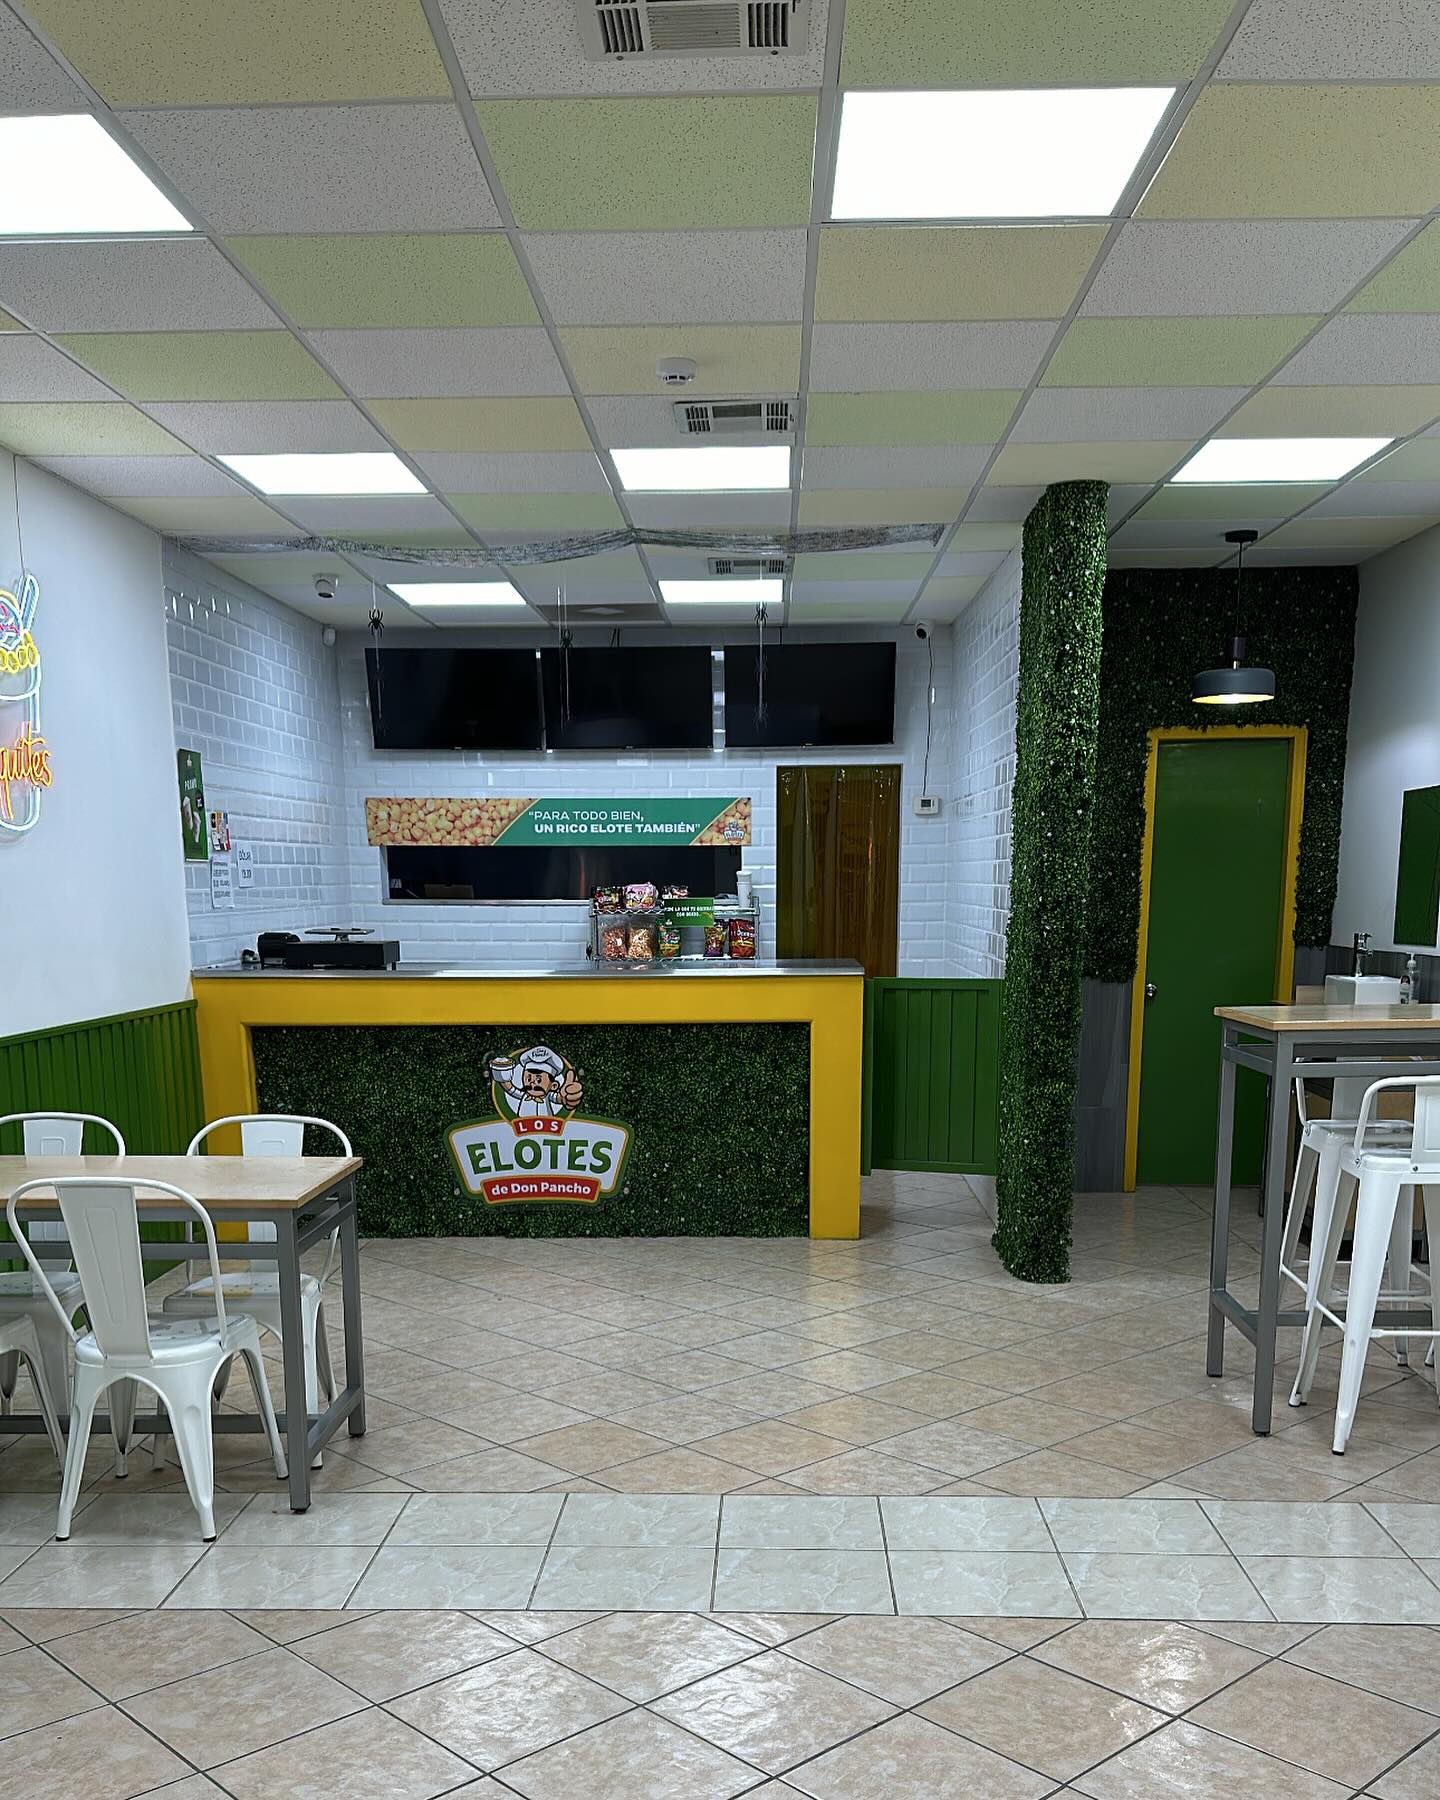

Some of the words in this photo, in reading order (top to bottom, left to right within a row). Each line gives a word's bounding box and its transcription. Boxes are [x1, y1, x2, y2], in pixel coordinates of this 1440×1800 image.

[573, 811, 607, 820] TODO
[611, 811, 644, 821] BIEN,
[535, 824, 553, 833] UN
[556, 824, 587, 833] RICO
[591, 824, 632, 833] ELOTE
[519, 1120, 559, 1132] LOS
[466, 1139, 613, 1175] ELOTES
[491, 1184, 508, 1195] de
[511, 1183, 538, 1193] Don
[541, 1182, 591, 1194] Pancho
